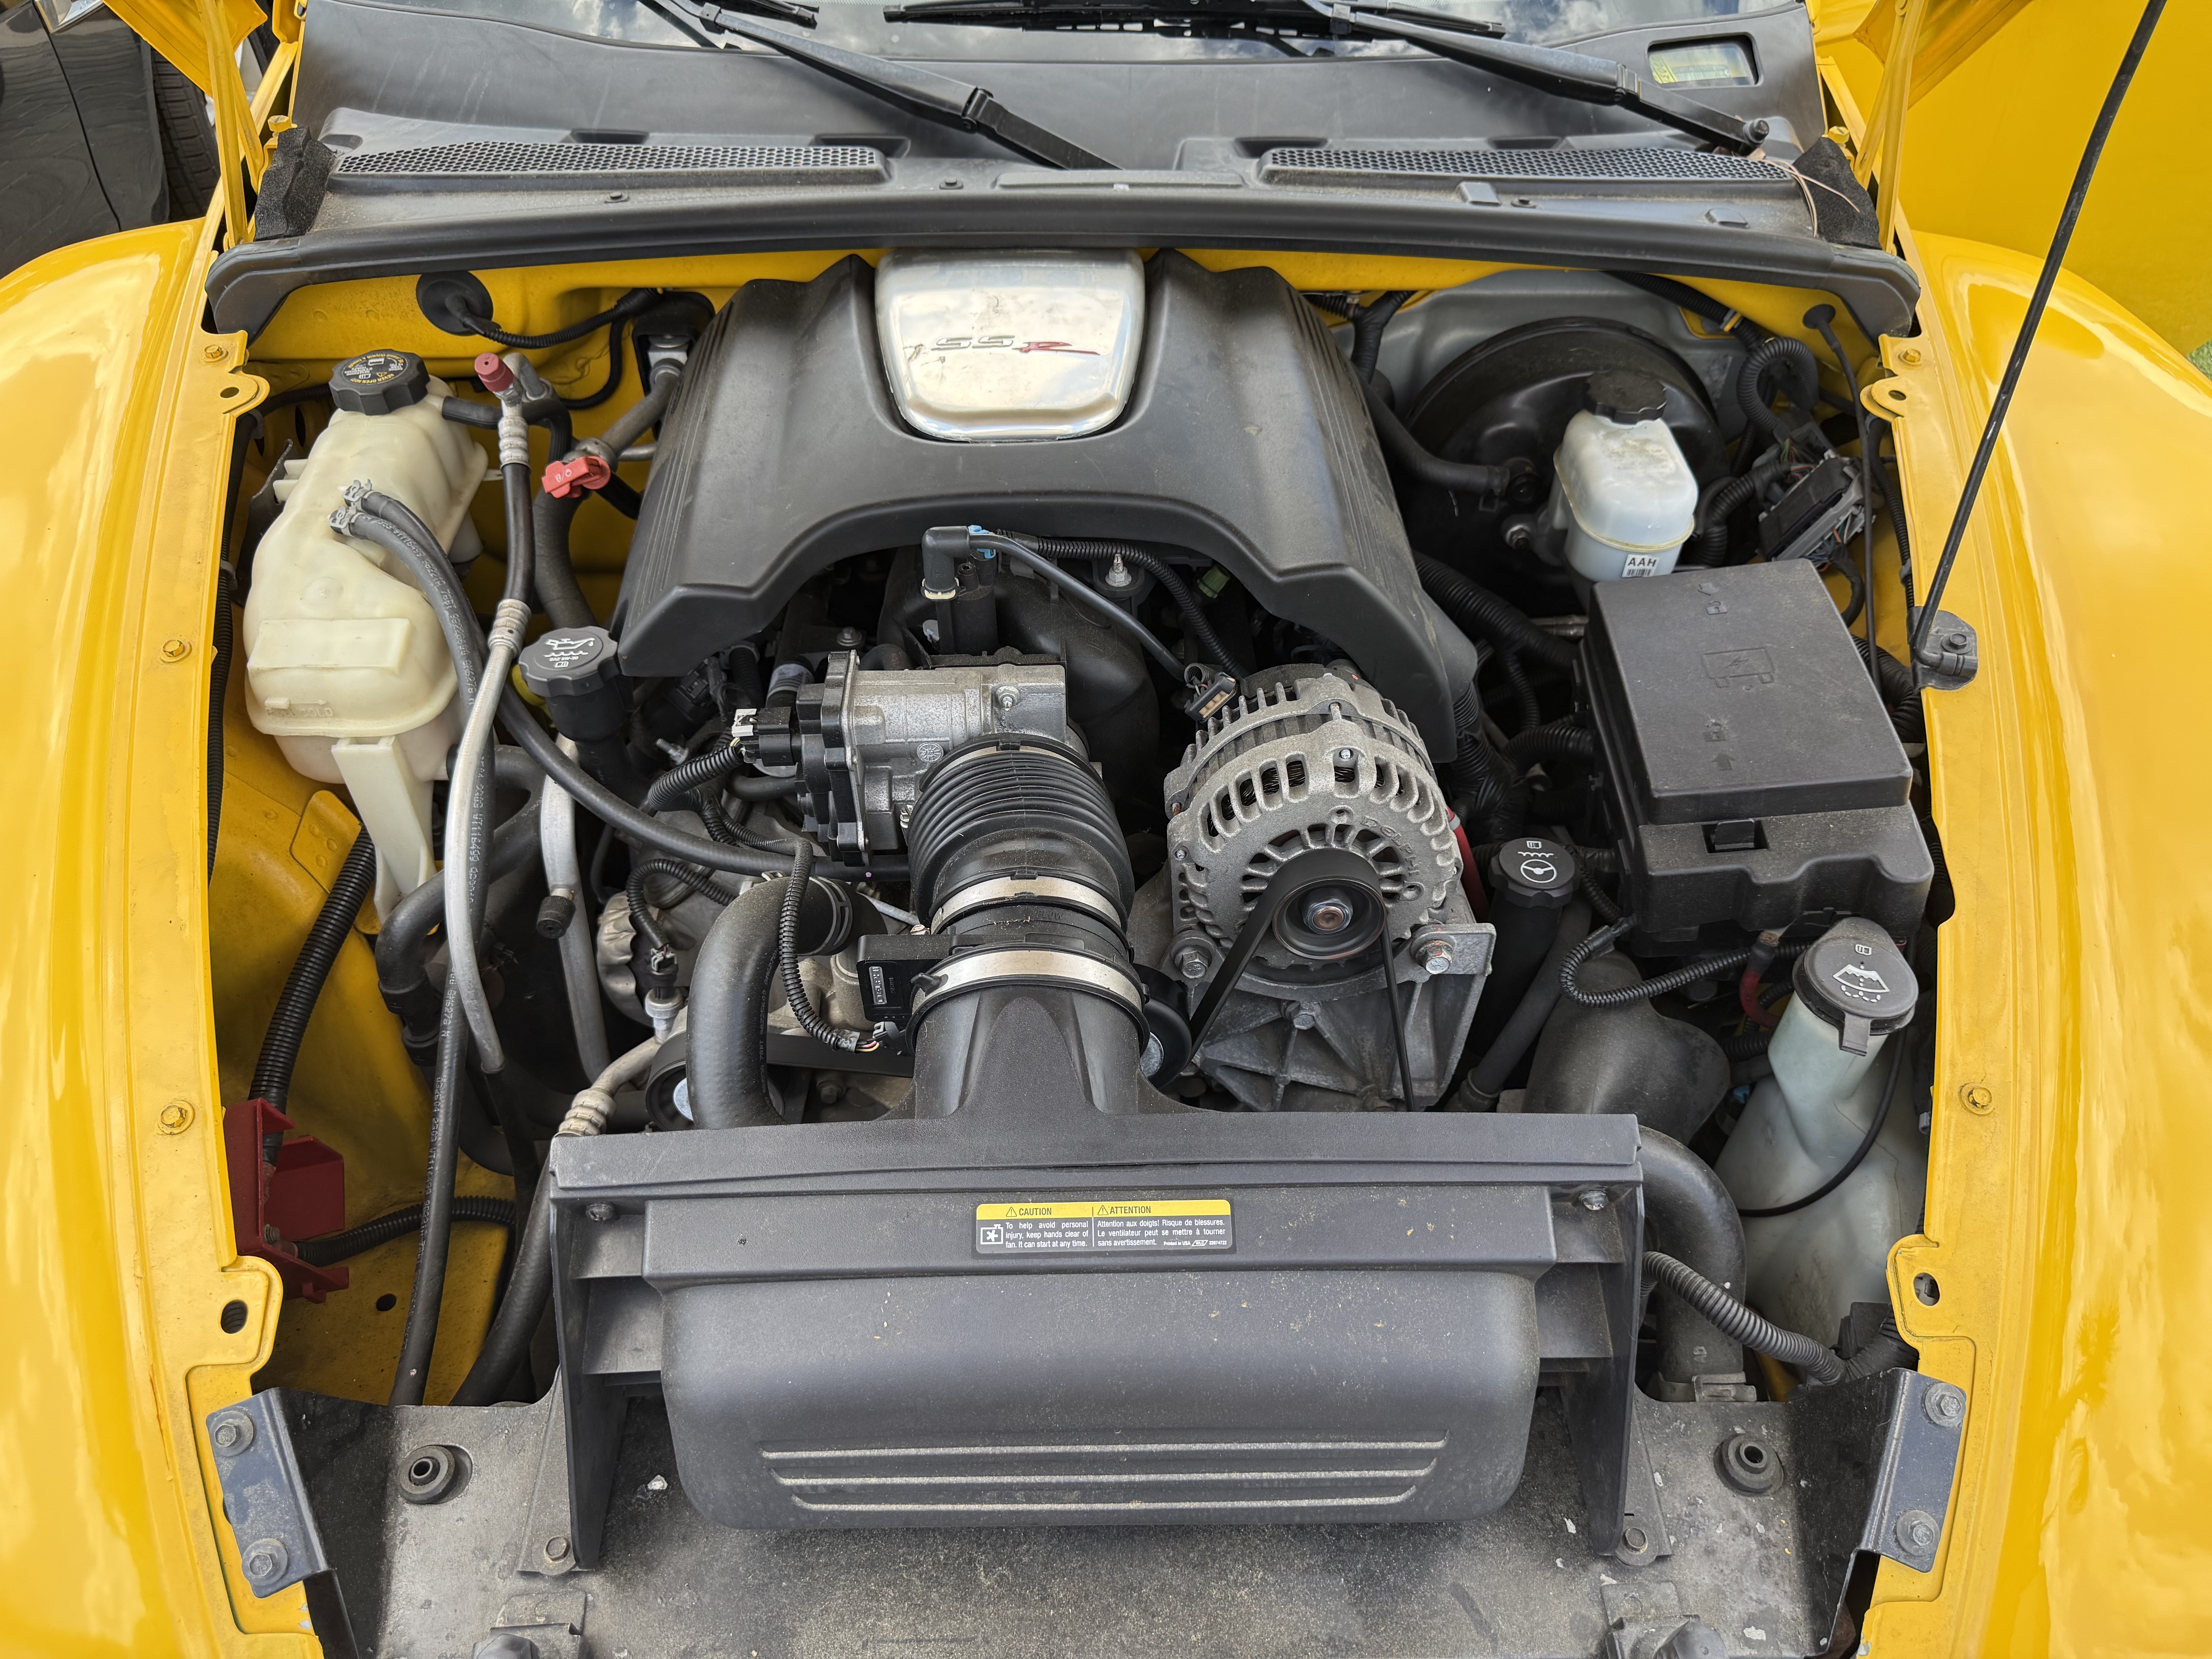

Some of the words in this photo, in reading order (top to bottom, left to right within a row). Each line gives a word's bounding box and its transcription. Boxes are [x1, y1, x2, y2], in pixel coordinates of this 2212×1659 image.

[931, 335, 1101, 356] SSR
[1627, 556, 1657, 568] AAH
[1360, 815, 1420, 876] DELPHI
[1019, 1207, 1051, 1216] CAUTION
[1109, 1206, 1151, 1214] ATTENTION
[1019, 1222, 1032, 1230] help
[1139, 1219, 1159, 1228] doigts!
[1162, 1219, 1182, 1227] Risque
[1006, 1231, 1024, 1240] injury,
[1026, 1231, 1041, 1239] keep
[1144, 1229, 1158, 1237] peut
